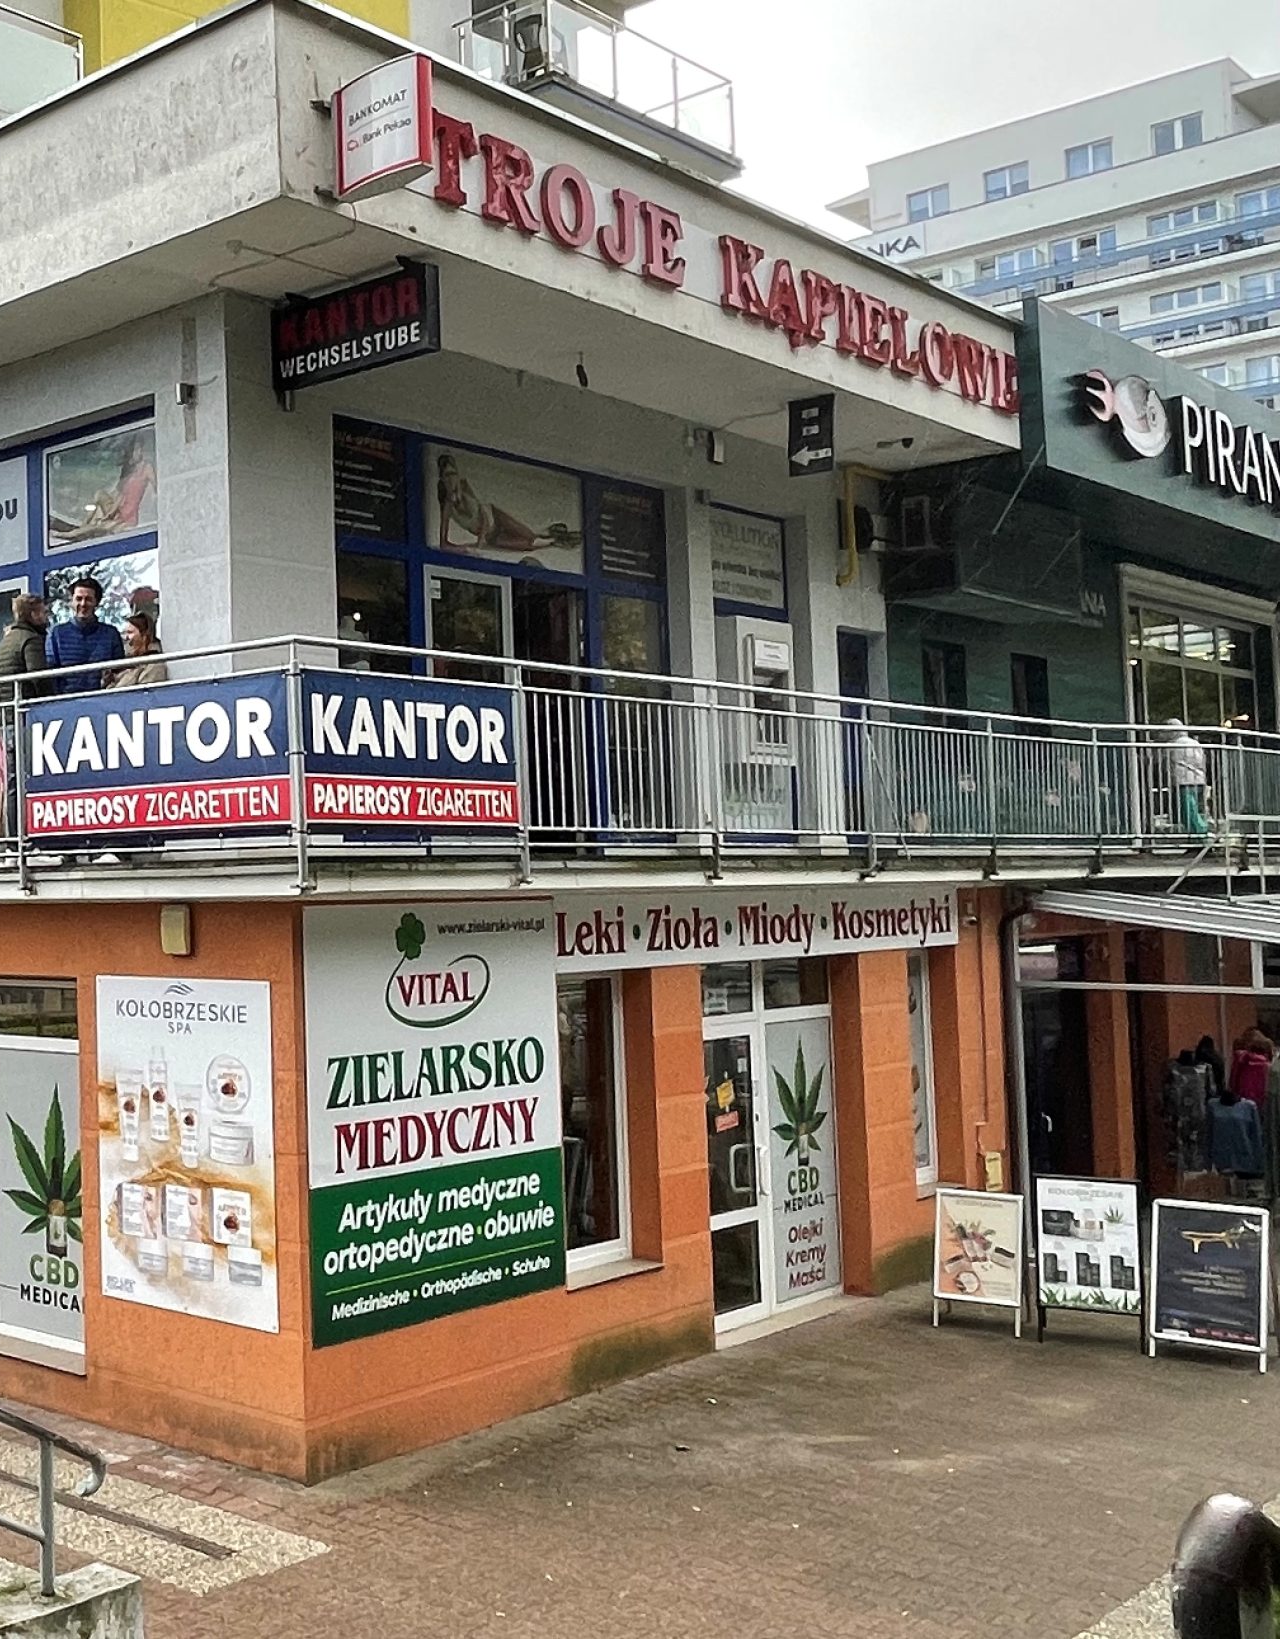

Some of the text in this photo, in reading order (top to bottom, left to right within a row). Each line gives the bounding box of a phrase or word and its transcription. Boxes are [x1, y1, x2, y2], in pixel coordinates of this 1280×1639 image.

[348, 89, 407, 127] BANKOMAT
[362, 118, 412, 144] Bank Pekao
[278, 277, 419, 352] KANTOR
[279, 321, 421, 378] WECHSELSTUBE
[31, 696, 276, 777] KANTOR
[310, 692, 509, 765] KANTOR
[32, 793, 140, 829] PAPIEROSY
[145, 785, 280, 823] ZIGARETTEN
[313, 783, 512, 818] PAPIEROSY ZIGARETTEN
[555, 895, 952, 957] Leki Zioła Miody Kosmetyki
[396, 971, 476, 1008] VITAL
[116, 999, 248, 1023] KOŁOBRZESKIE
[168, 1021, 192, 1034] SPA
[326, 1036, 544, 1110] ZIELARSKO
[334, 1097, 540, 1175] MEDYCZNY
[787, 1166, 819, 1197] CBD
[338, 1173, 540, 1233] Artykuły medyczne
[784, 1191, 825, 1214] MEDICAL
[324, 1201, 555, 1276] ortopedyczne obuwie
[788, 1217, 823, 1243] Olejki
[30, 1254, 79, 1288] CBD
[786, 1243, 826, 1268] Kremy
[332, 1289, 410, 1320] Medizinische
[421, 1266, 502, 1298] Orthopädische
[789, 1261, 826, 1289] Maści
[20, 1283, 85, 1314] MEDICA
